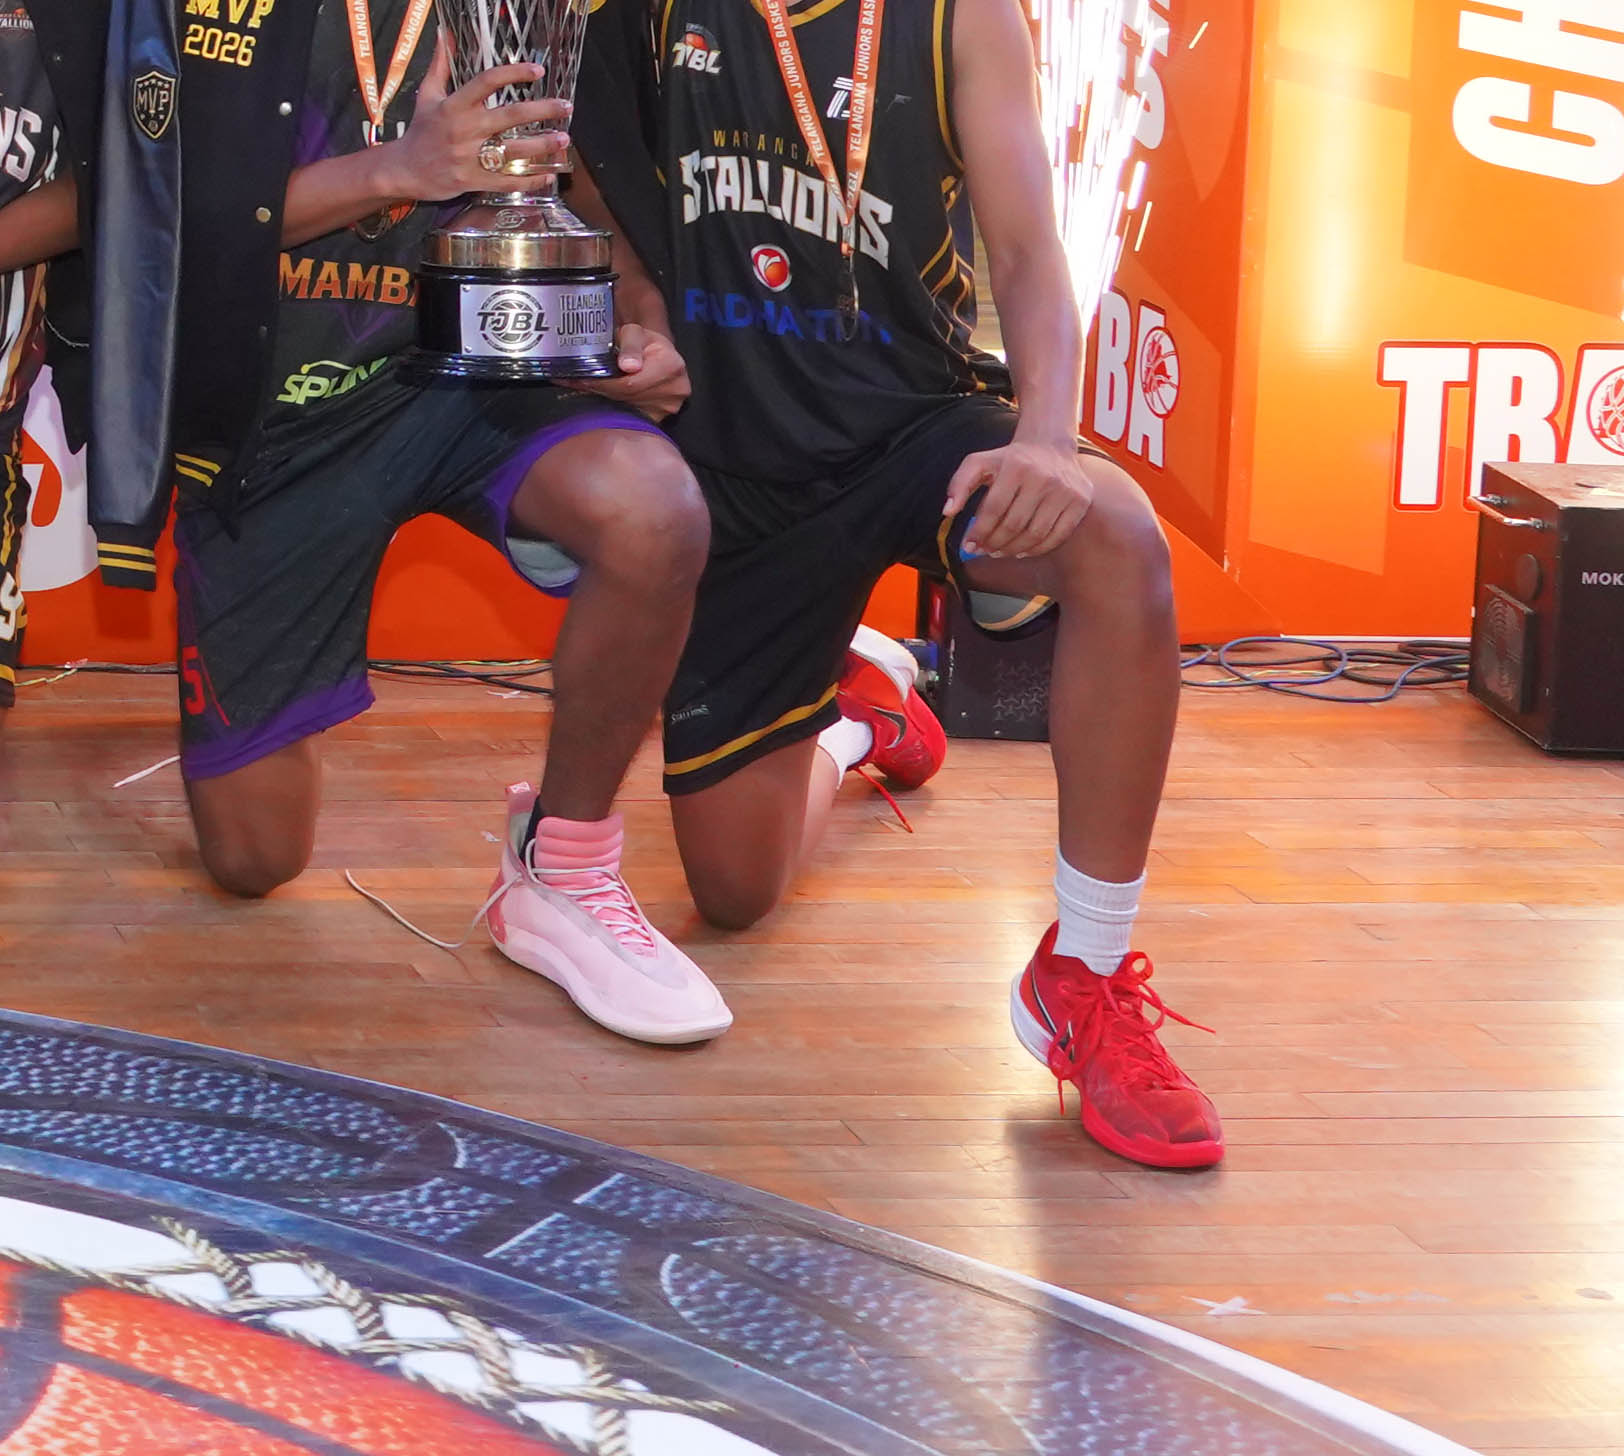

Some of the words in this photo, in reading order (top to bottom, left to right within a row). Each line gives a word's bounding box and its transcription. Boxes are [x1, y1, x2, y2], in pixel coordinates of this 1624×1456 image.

[183, 23, 257, 67] 2026
[780, 40, 803, 90] JUNIORS
[858, 30, 874, 80] JUNIORS
[135, 86, 170, 113] MVP
[799, 90, 825, 158] TELANGANA
[850, 82, 868, 152] TELANGANA
[713, 130, 816, 167] WARANGA
[679, 149, 894, 271] STALLIONS
[278, 251, 418, 307] MAMB
[477, 312, 550, 332] TJBL
[557, 311, 608, 336] JUNIORS
[1093, 289, 1166, 470] BA
